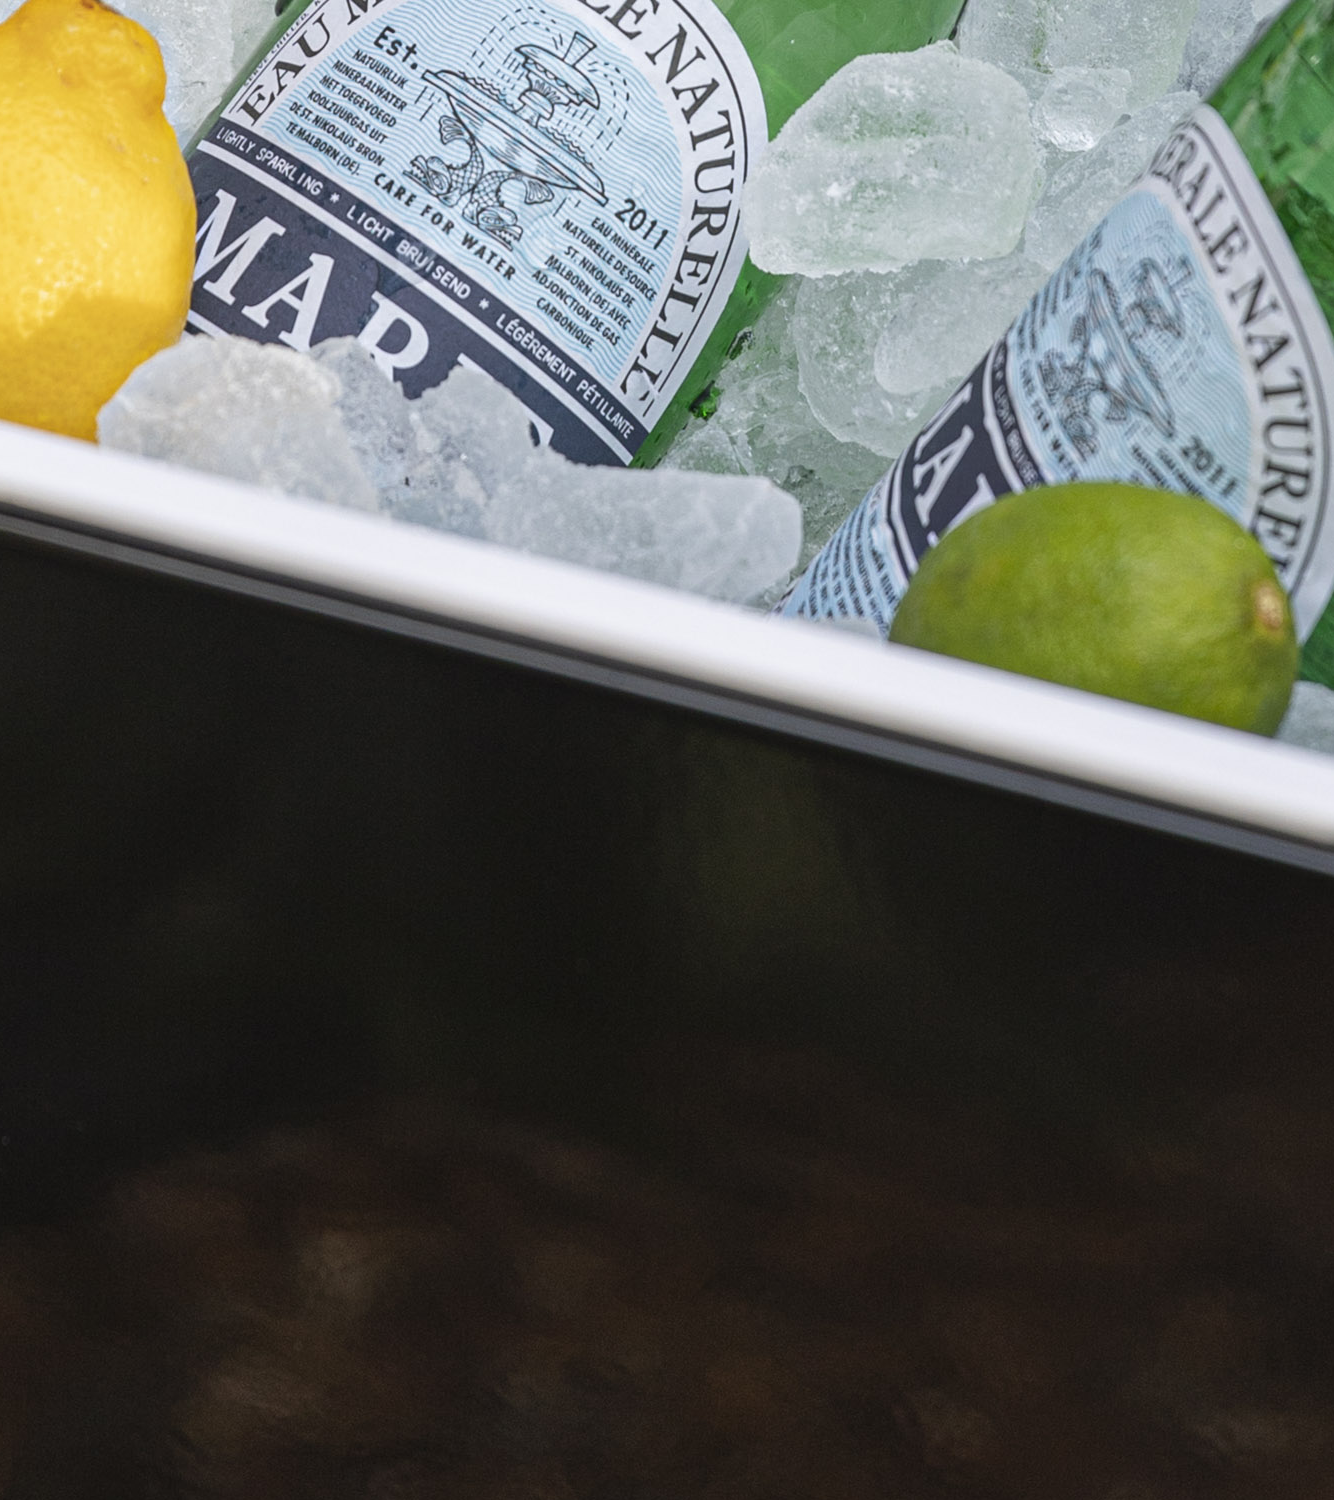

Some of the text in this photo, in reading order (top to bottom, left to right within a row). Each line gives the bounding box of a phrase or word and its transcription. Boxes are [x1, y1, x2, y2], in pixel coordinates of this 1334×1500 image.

[236, 12, 332, 127] EAU
[352, 50, 409, 91] NATUURLIJK
[373, 26, 419, 71] Est.
[306, 88, 389, 146] KOOLZUURGAS UIT
[318, 74, 397, 128] MET TOEGEVOEGD
[332, 60, 408, 112] MINERAALWATER
[216, 126, 324, 196] LIGHTLY SPARKLING
[285, 121, 298, 133] TE
[294, 127, 341, 165] MALBORN
[288, 101, 301, 115] DE
[312, 115, 361, 152] NIKOLAUS
[357, 140, 386, 167] BRON
[346, 204, 472, 300] LICHT BRUISEND
[373, 172, 518, 281] CARE FOR WATER
[590, 217, 656, 275] EAU MINÉRALE
[614, 198, 669, 250] 2011
[562, 219, 658, 302] NATURELLE DE SOURCE
[577, 256, 626, 298] NIKOLAUS
[621, 292, 636, 309] DE
[531, 269, 621, 347] ADJONCTION DE GAS
[544, 254, 632, 331] MALBORN (DE) AVEC
[495, 313, 635, 439] LÉGÈREMENT PÉTILLANTE
